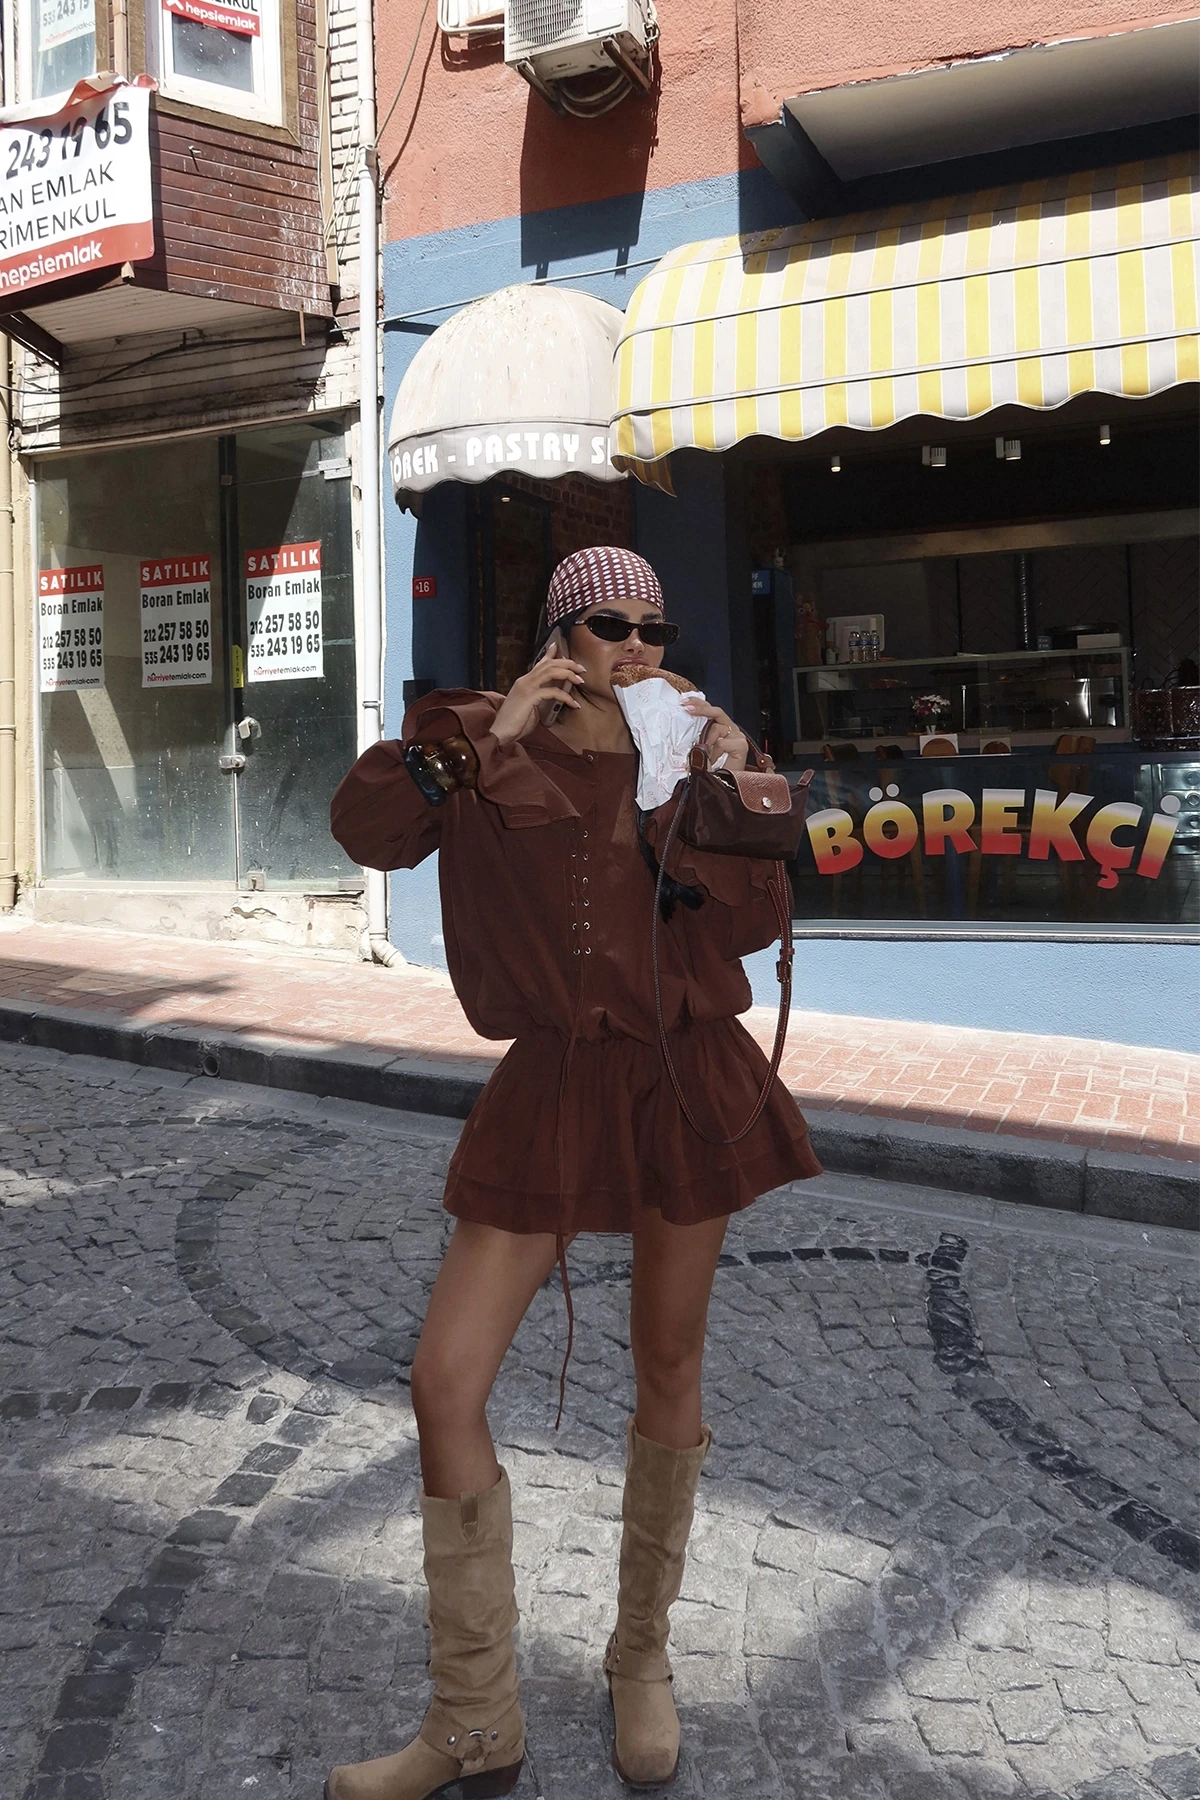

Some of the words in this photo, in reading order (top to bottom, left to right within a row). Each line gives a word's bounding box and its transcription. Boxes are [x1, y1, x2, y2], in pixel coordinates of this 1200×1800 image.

[186, 2, 256, 30] hepsiemlak
[6, 128, 53, 180] 243
[61, 117, 87, 160] 19
[95, 102, 133, 150] 65
[31, 161, 114, 205] EMLAK
[390, 444, 439, 483] ÖREK
[466, 432, 580, 467] PASTRY
[142, 560, 208, 582] SATILIK
[248, 549, 319, 572] SATILIK
[40, 570, 102, 590] SATILIK
[248, 584, 281, 600] Boran
[285, 578, 320, 596] Emlak
[41, 602, 68, 616] Boran
[72, 597, 103, 614] Emlak
[142, 593, 173, 609] Boran
[176, 588, 210, 605] Emlak
[144, 629, 156, 642] 212
[158, 622, 176, 641] 257
[179, 621, 192, 640] 58
[195, 619, 209, 638] 50
[250, 621, 263, 635] 212
[265, 614, 284, 634] 257
[288, 612, 302, 632] 58
[305, 610, 319, 630] 50
[42, 636, 53, 649] 212
[55, 629, 71, 648] 257
[74, 628, 86, 647] 58
[88, 627, 102, 646] 50
[251, 644, 264, 658] 535
[267, 637, 288, 657] 243
[291, 635, 302, 655] 19
[306, 634, 320, 653] 65
[43, 657, 55, 670] 535
[57, 651, 74, 670] 243
[76, 650, 87, 668] 19
[90, 649, 102, 667] 65
[144, 651, 158, 665] 535
[160, 644, 179, 664] 243
[182, 643, 193, 662] 19
[196, 642, 210, 661] 65
[805, 783, 1180, 890] BÖREKÇİ
